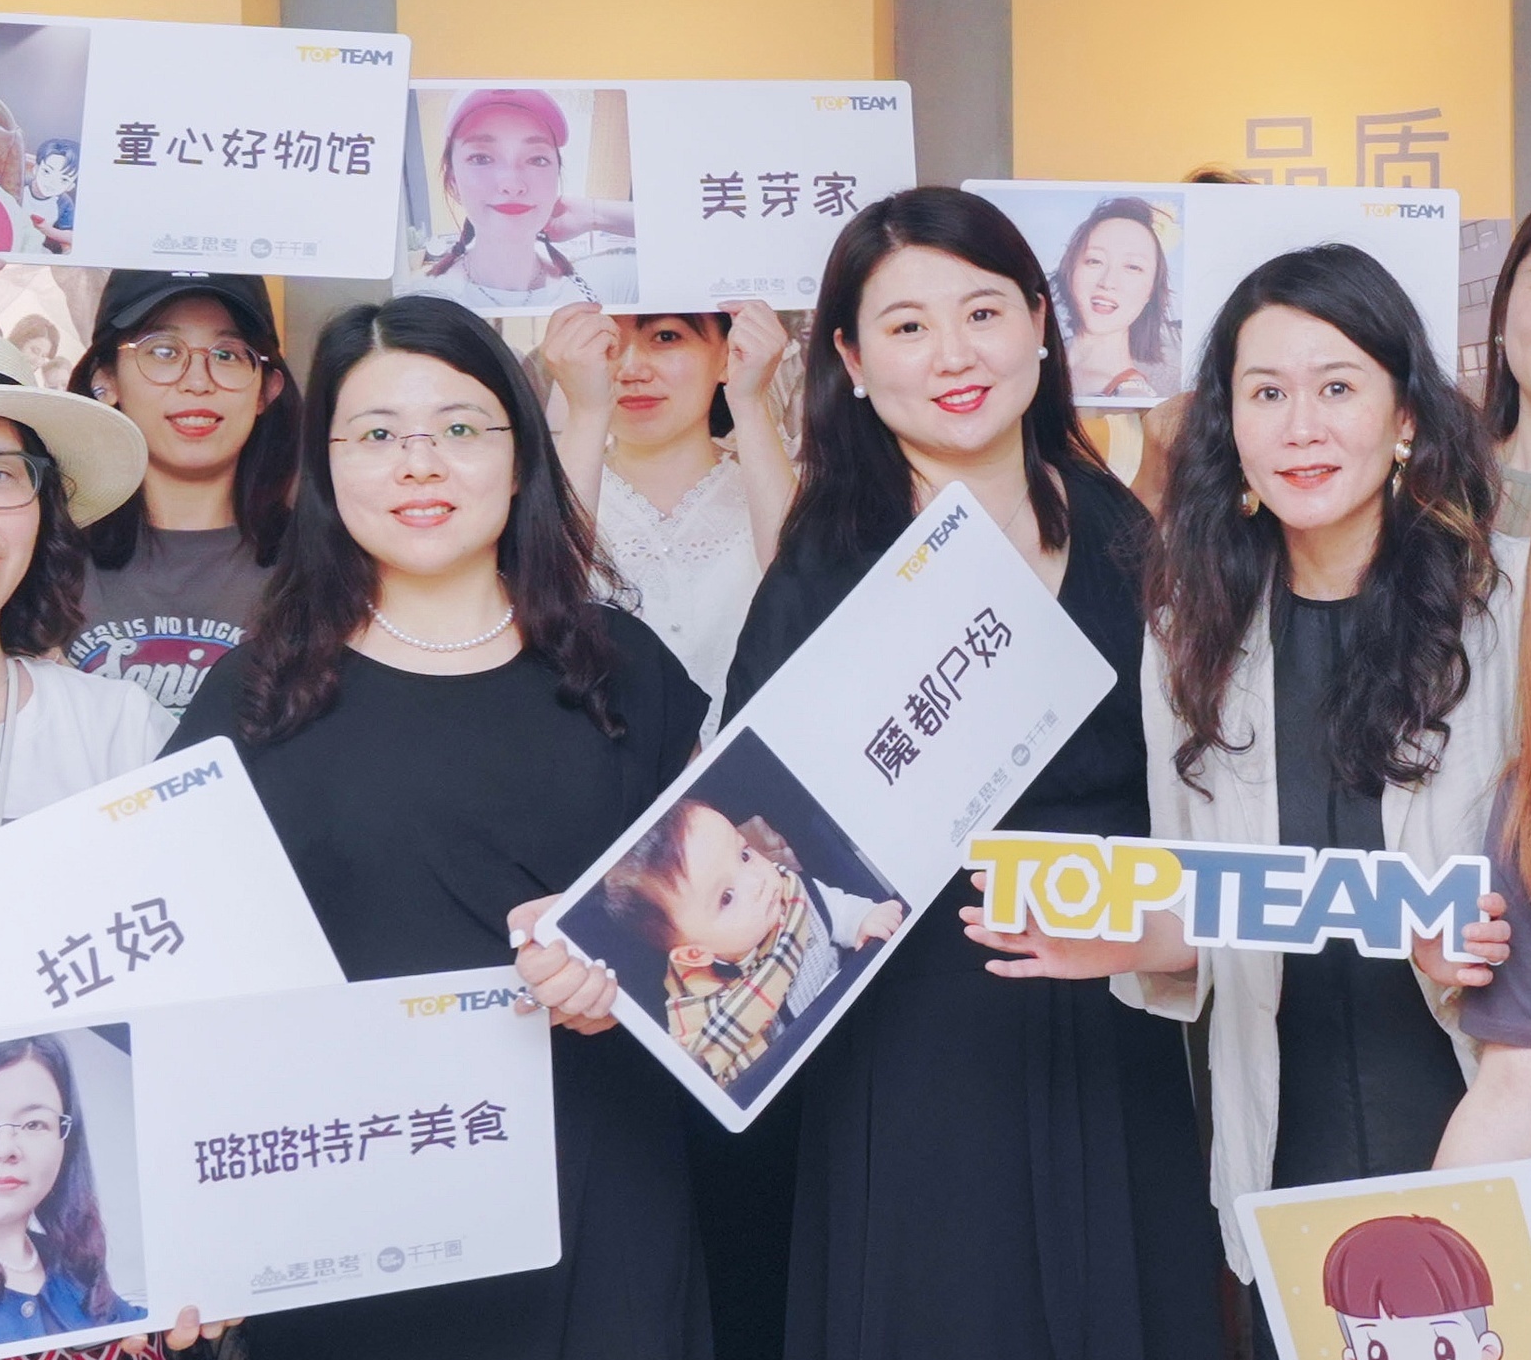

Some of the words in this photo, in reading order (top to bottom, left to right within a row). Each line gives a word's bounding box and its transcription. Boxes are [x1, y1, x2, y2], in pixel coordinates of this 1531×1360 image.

[296, 45, 393, 66] TOPTEAM
[811, 96, 897, 111] TOPTEAM
[114, 121, 376, 176] 童心好物馆
[1236, 107, 1449, 188] 品质
[700, 171, 859, 220] 美芽家
[1360, 202, 1445, 219] TOPTEAM
[895, 504, 969, 584] TOPTEAM
[124, 618, 148, 637] IS
[154, 616, 182, 635] NO
[187, 617, 247, 644] LUCK
[99, 761, 224, 822] TOPTEAM
[969, 840, 1483, 956] TOPTEAM
[36, 896, 186, 1009] 拉妈
[195, 1100, 509, 1184] 璐璐特产美食
